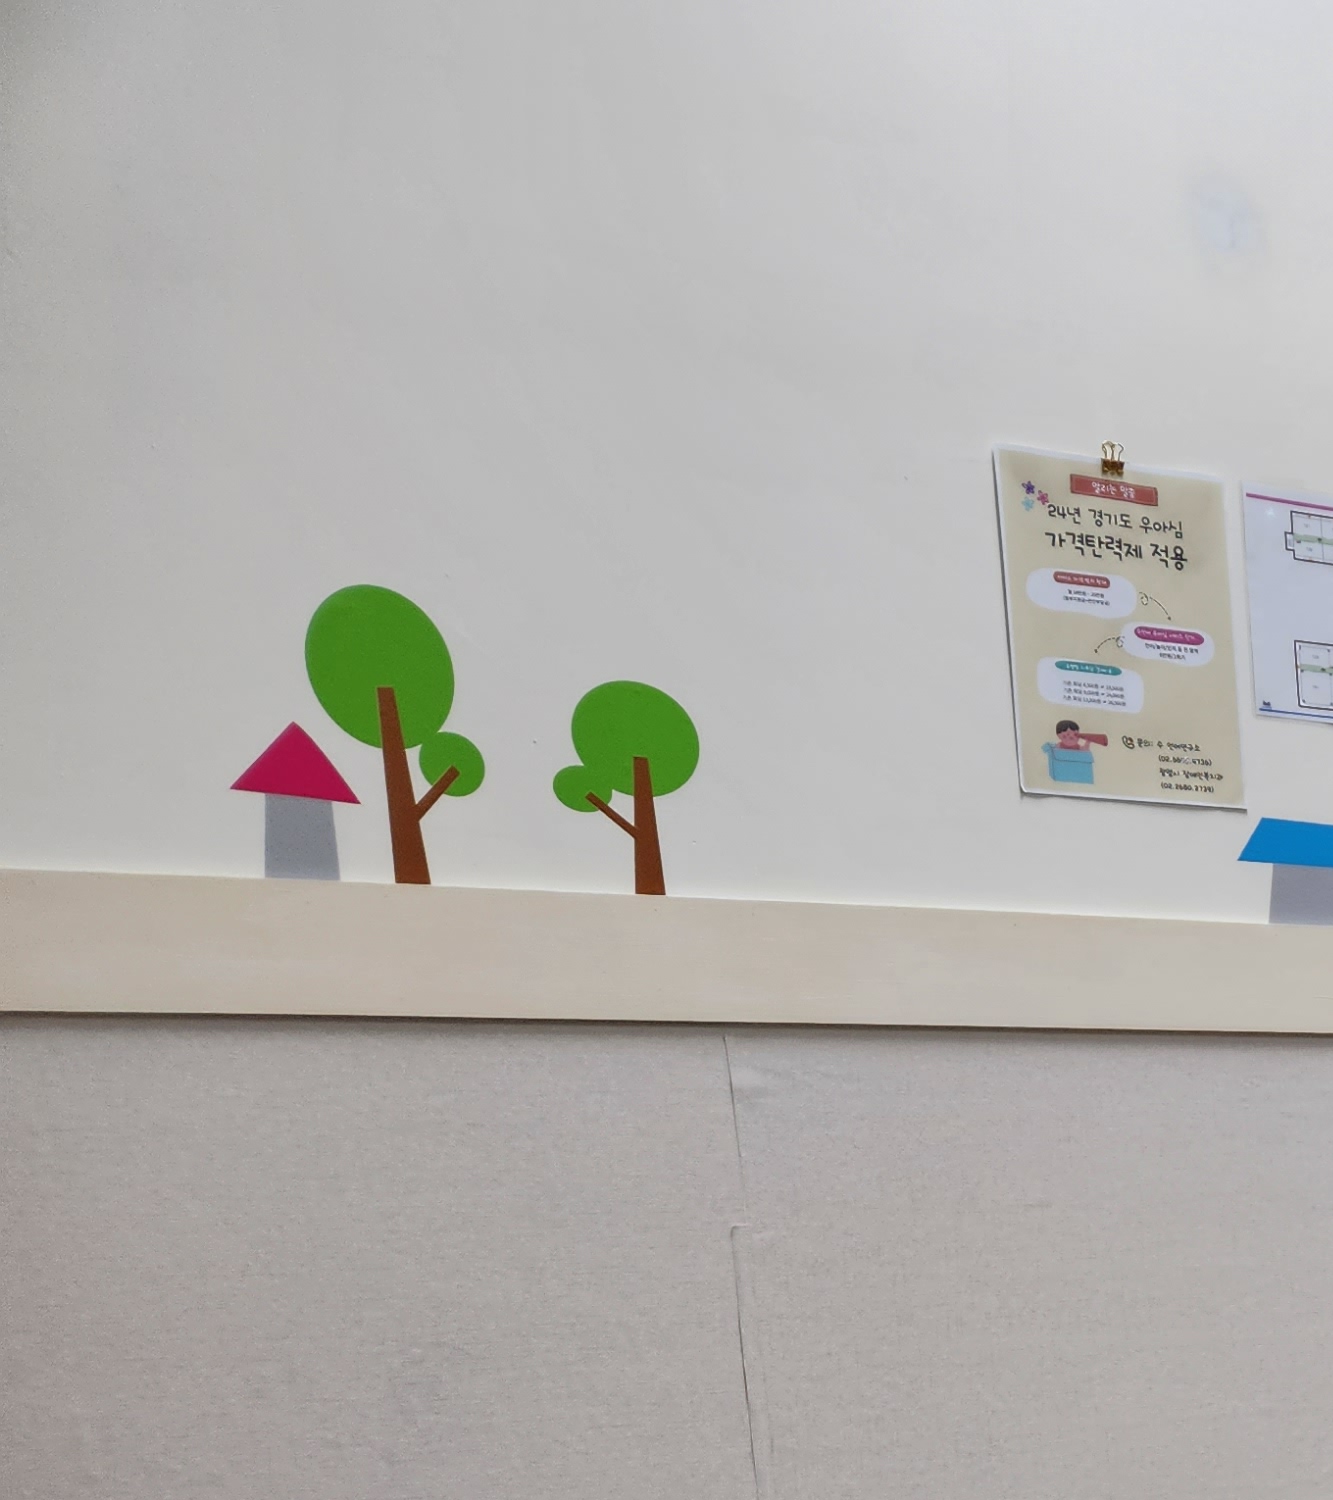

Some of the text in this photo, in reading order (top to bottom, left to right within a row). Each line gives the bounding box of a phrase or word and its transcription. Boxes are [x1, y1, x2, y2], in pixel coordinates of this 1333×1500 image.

[1047, 504, 1183, 539] 24년 경기도 우아심
[1044, 532, 1188, 570] 가격탄력제 적용
